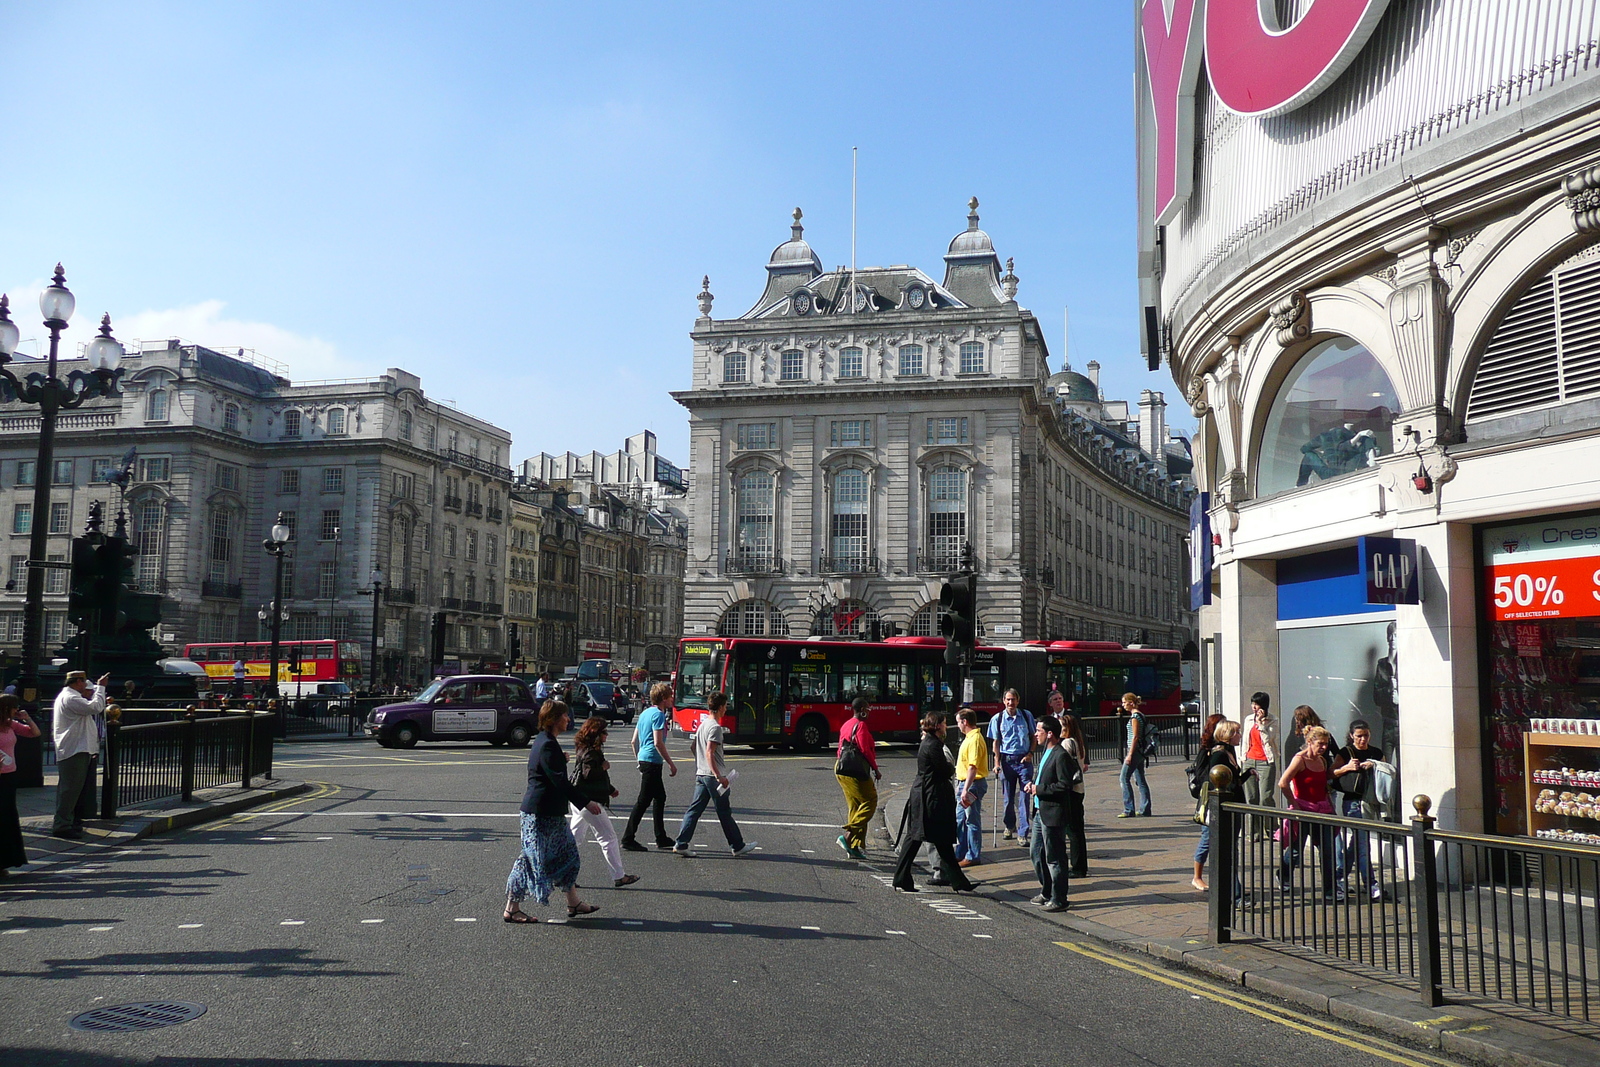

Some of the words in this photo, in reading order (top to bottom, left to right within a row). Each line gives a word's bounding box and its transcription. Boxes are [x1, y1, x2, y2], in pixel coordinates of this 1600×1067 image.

[1542, 525, 1600, 543] Cres
[1373, 552, 1410, 589] GAP
[1494, 573, 1564, 608] 50%
[1516, 625, 1539, 636] SALE
[823, 664, 832, 673] 12
